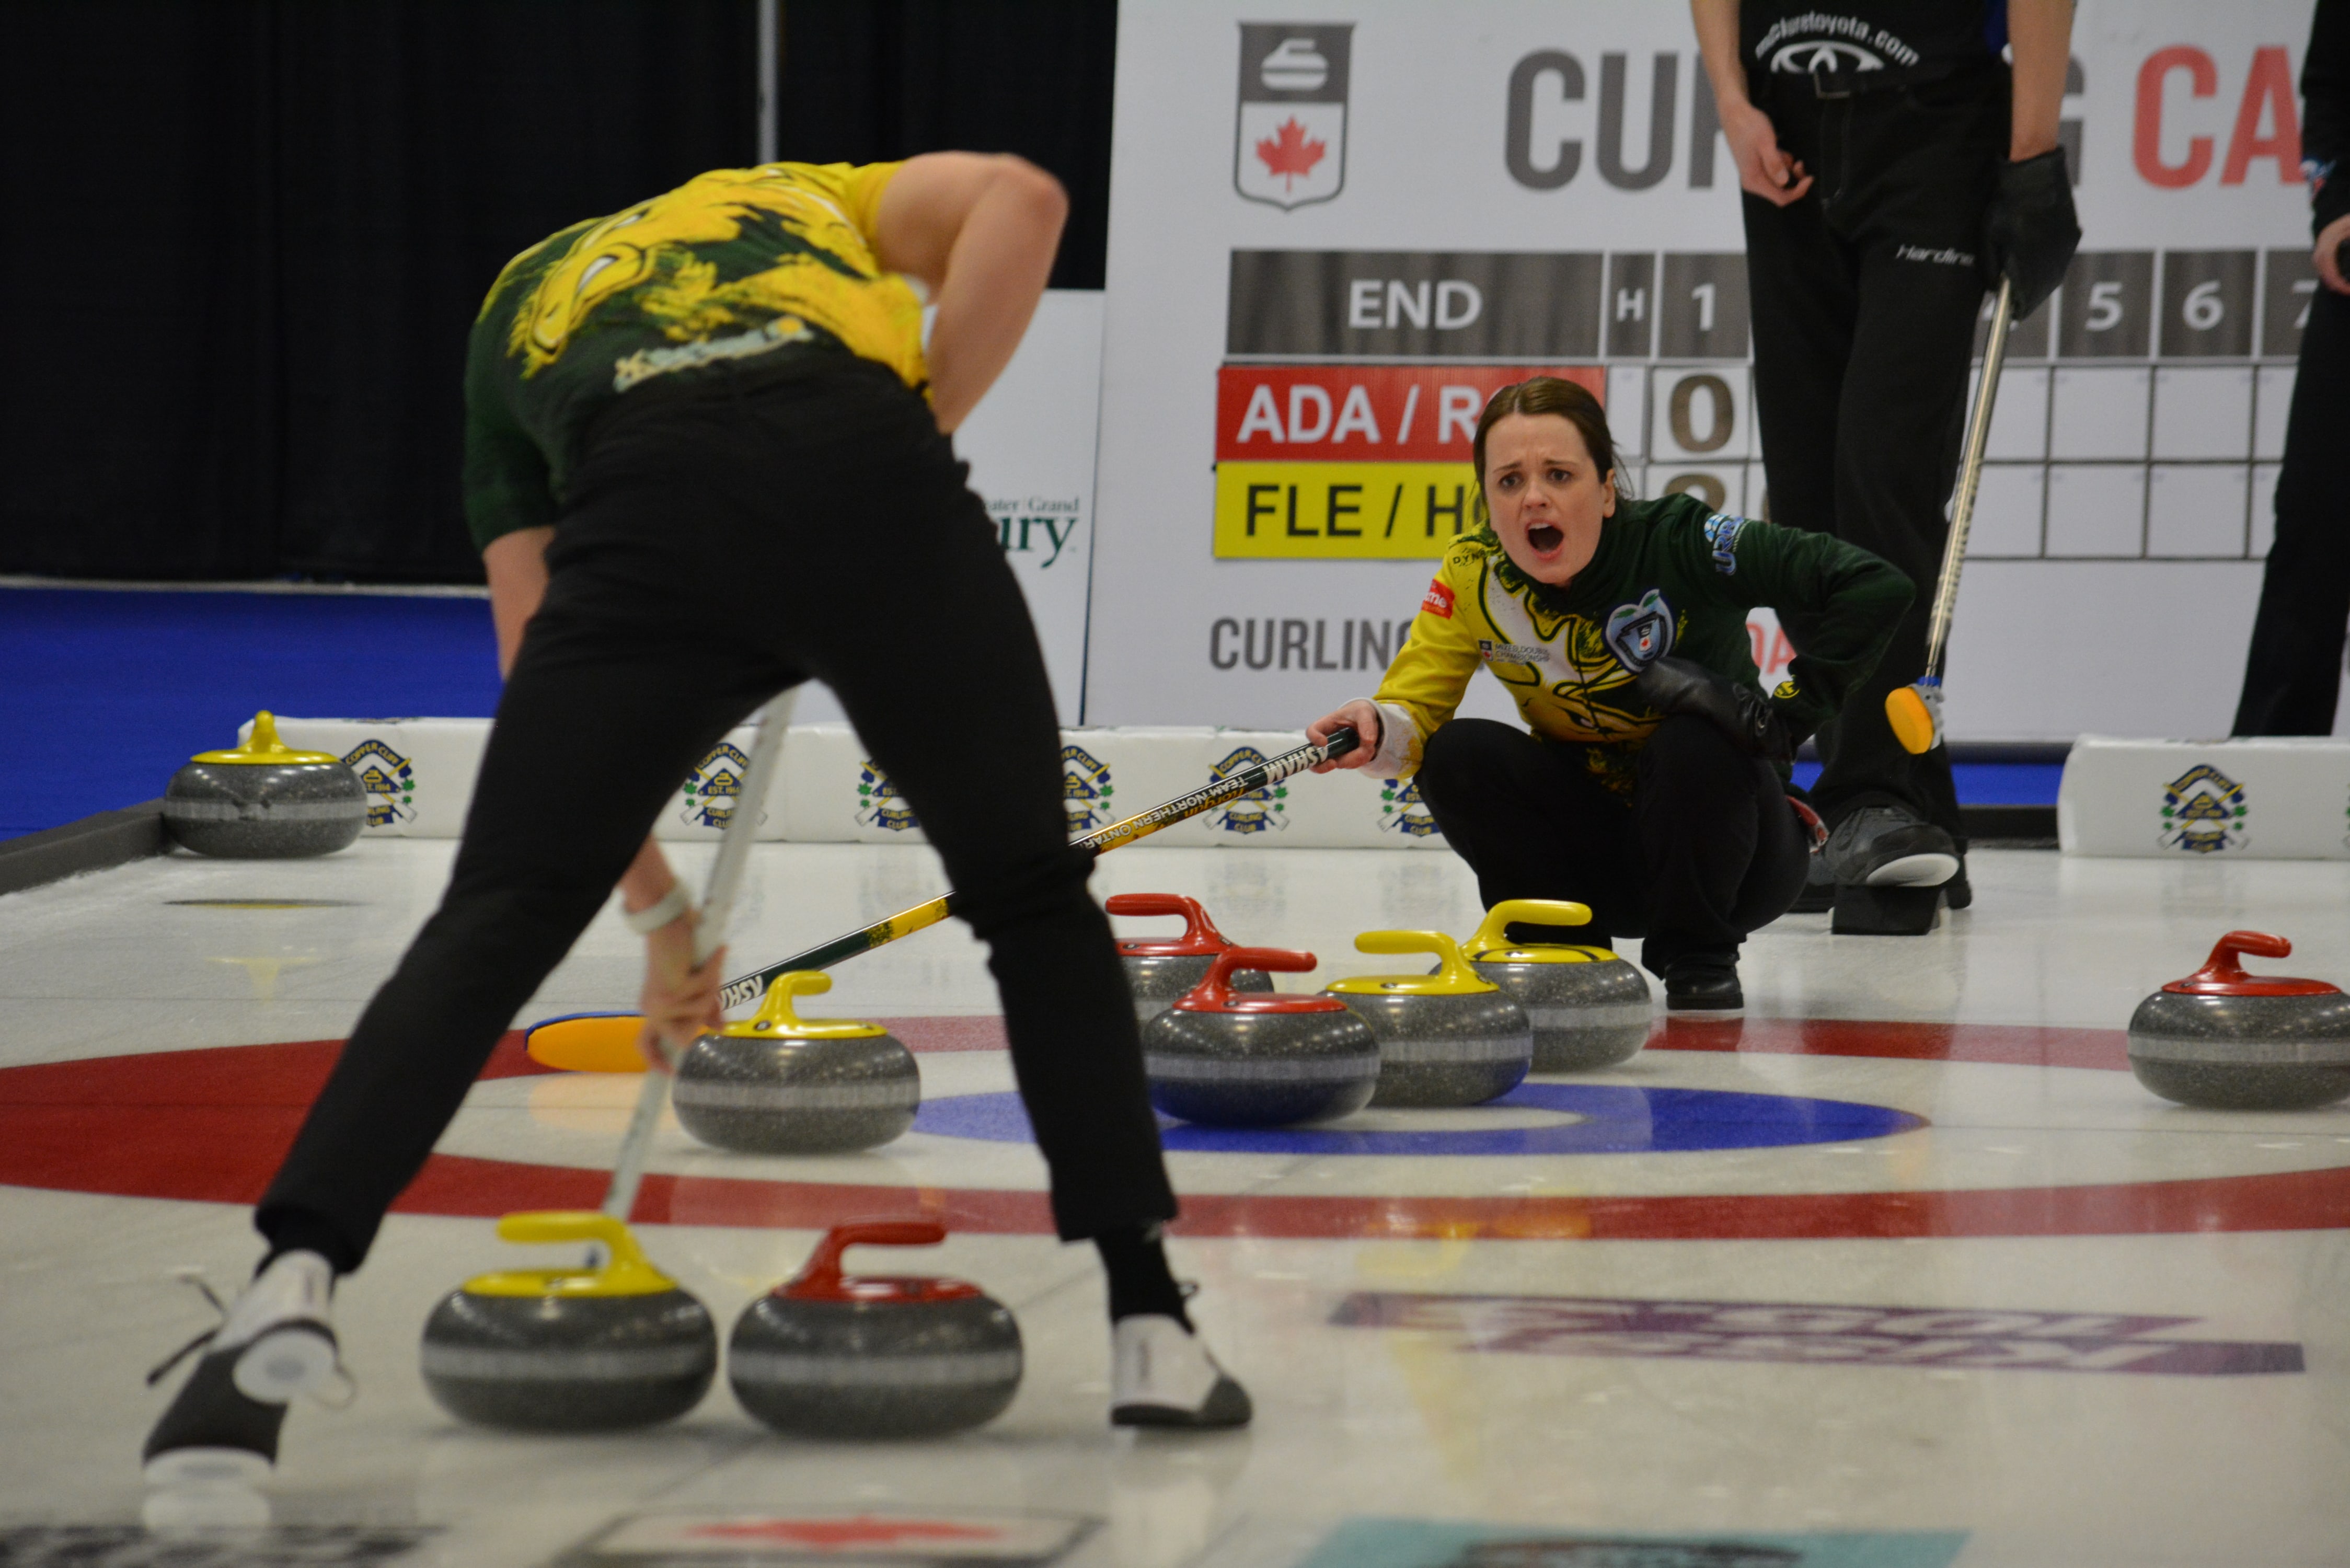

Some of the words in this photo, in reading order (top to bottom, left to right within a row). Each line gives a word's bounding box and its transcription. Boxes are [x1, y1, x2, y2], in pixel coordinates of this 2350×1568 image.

[1349, 279, 1483, 330] END
[1616, 287, 1645, 322] H
[1691, 282, 1717, 331] 1
[2085, 281, 2124, 331] 5
[2183, 279, 2224, 331] 6
[1237, 385, 1381, 444] ADA
[1397, 384, 1421, 445] /
[1437, 384, 1502, 445] R
[1669, 373, 1735, 453] 0
[1028, 495, 1080, 512] Grand
[1246, 482, 1364, 538] FLE
[1385, 483, 1403, 538] /
[1208, 776, 1249, 797] TEAM
[1135, 790, 1209, 831] NORTHERN
[1080, 822, 1134, 850] ONTAR
